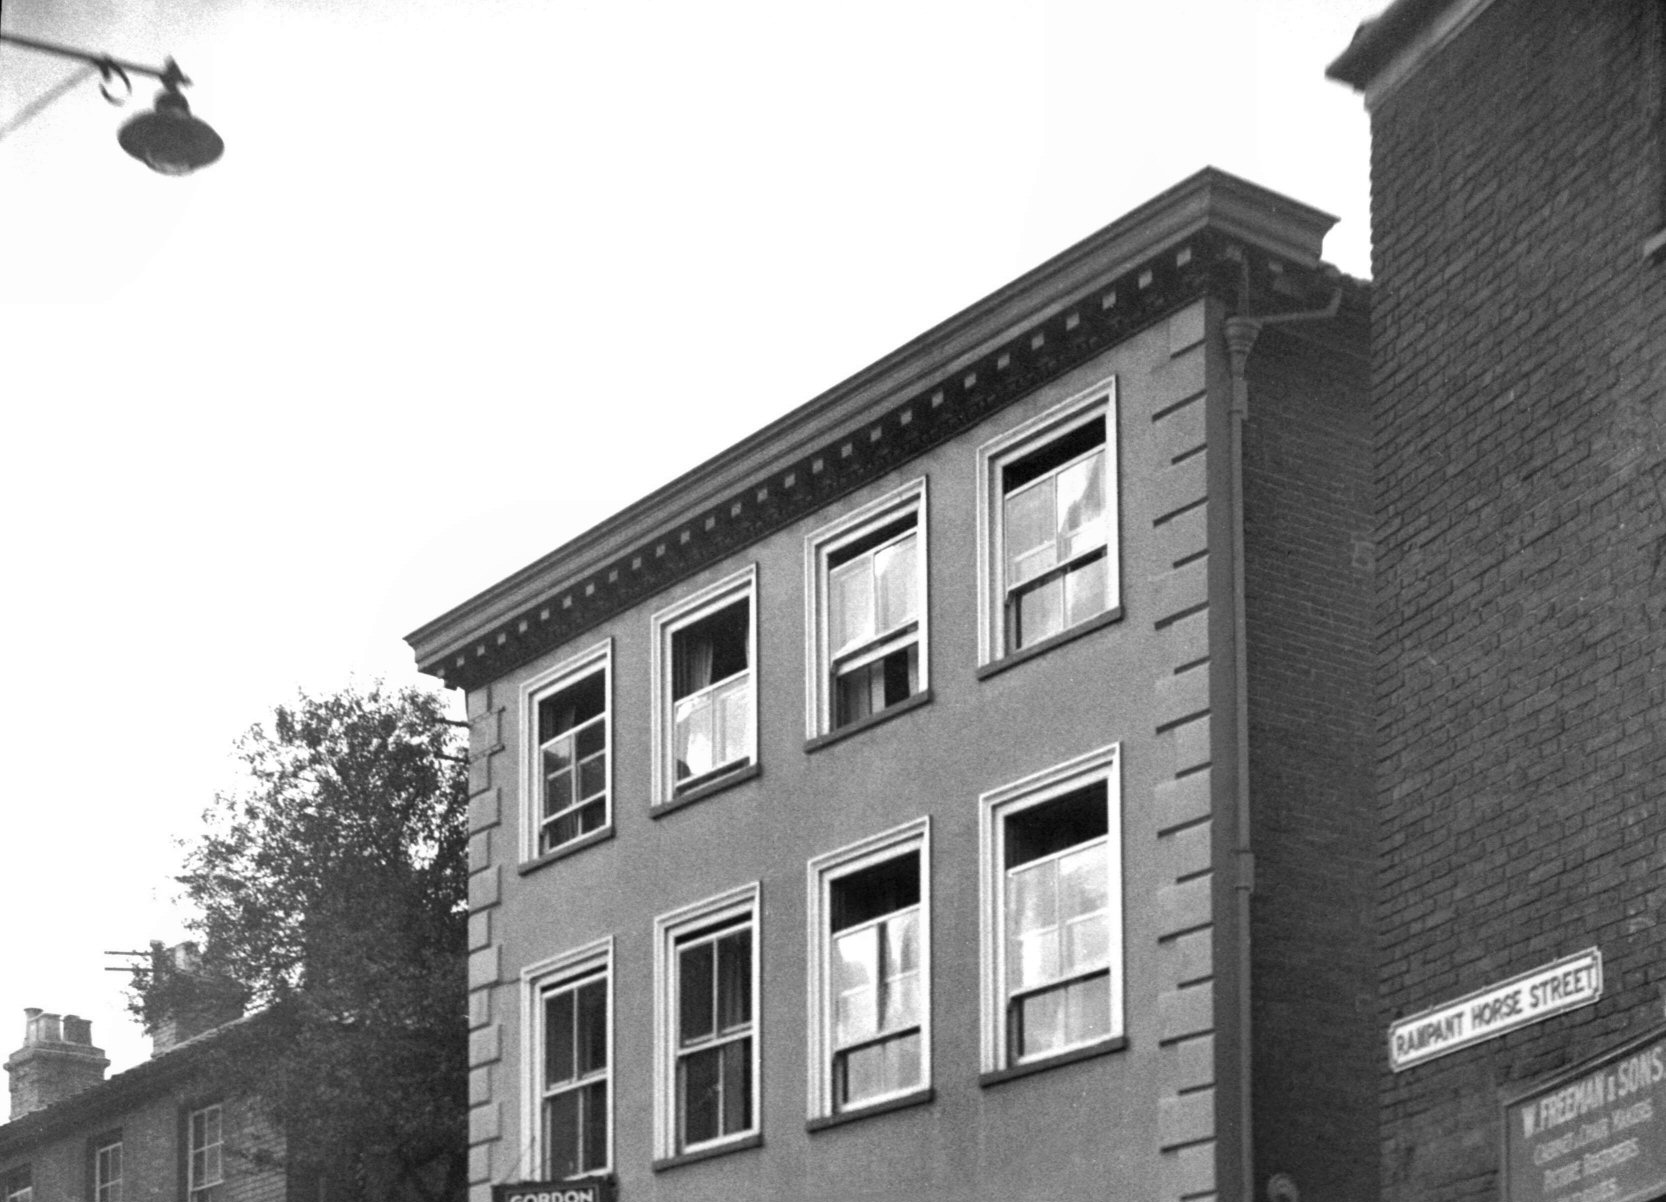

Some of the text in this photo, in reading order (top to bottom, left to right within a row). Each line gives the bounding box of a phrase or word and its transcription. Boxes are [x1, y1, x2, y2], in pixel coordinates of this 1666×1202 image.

[1396, 964, 1594, 1054] RAMPANT HORSE STREET
[1618, 1046, 1663, 1096] SONS
